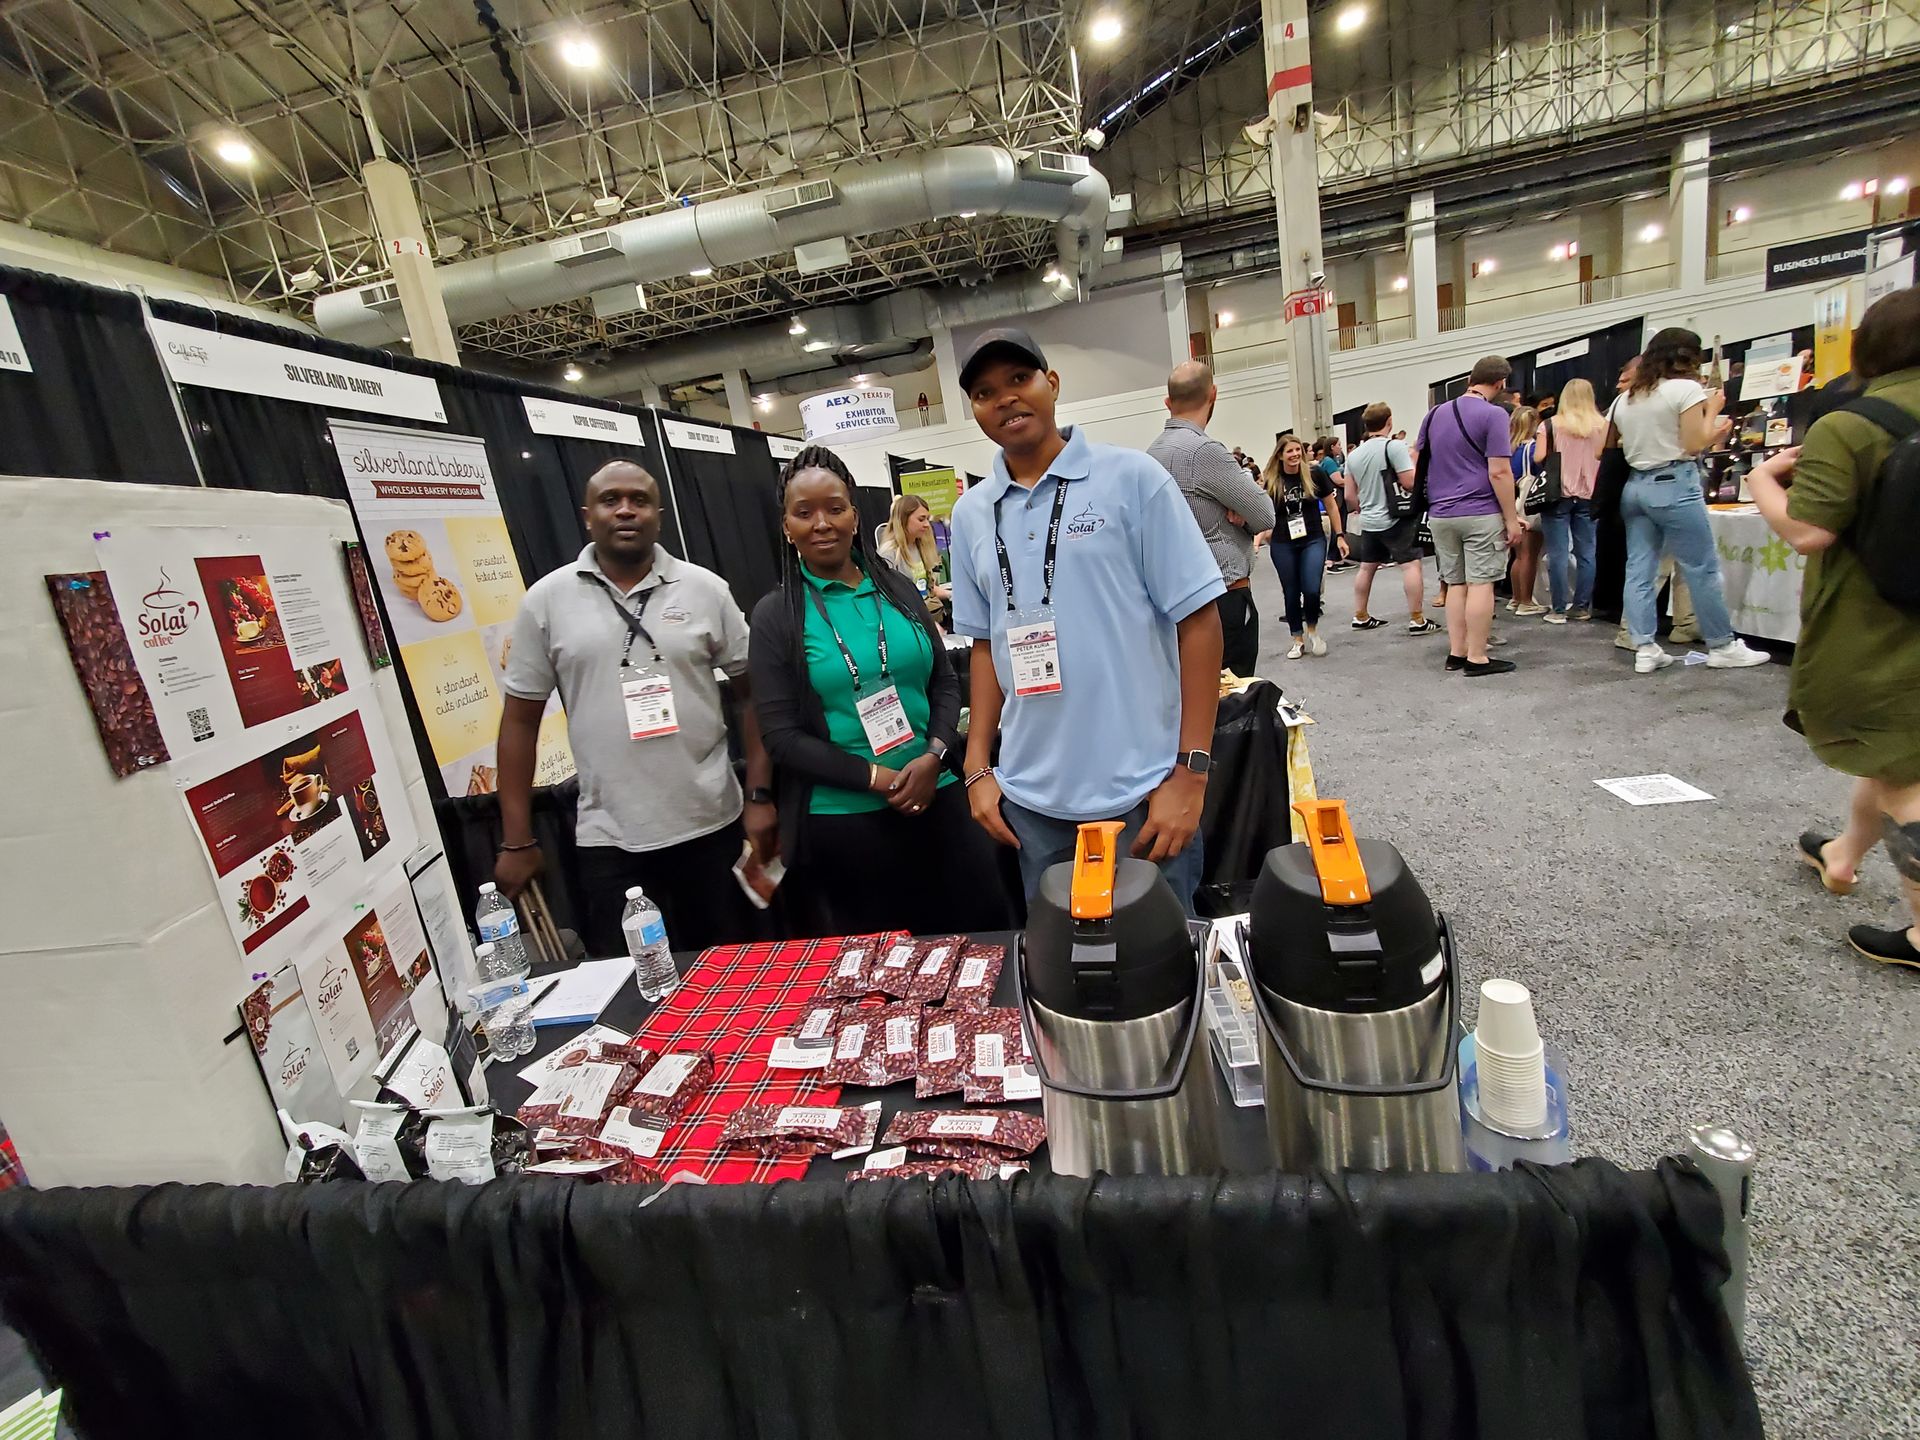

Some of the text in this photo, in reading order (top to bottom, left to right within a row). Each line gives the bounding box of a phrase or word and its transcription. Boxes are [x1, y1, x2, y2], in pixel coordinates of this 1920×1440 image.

[1285, 22, 1294, 39] 4
[393, 240, 402, 254] 2
[416, 241, 424, 256] 2
[1773, 256, 1820, 273] BUSINESS
[1821, 246, 1868, 264] BUILDING
[283, 363, 384, 397] SILVERLAND BAKERY
[826, 395, 852, 408] AEX
[835, 416, 895, 430] SERVICE CENTER
[846, 407, 887, 419] EXHIBITOR
[353, 448, 487, 486] silverland bakery
[379, 485, 480, 496] WHOLESALE BAKERY PROGRAM
[1066, 521, 1097, 535] Solai
[138, 606, 188, 636] Solai
[143, 635, 174, 649] coffee
[443, 672, 480, 695] standard
[436, 686, 489, 716] cuts included
[318, 976, 343, 1010] Solai
[281, 1054, 306, 1085] Solai
[424, 1074, 445, 1102] Solai
